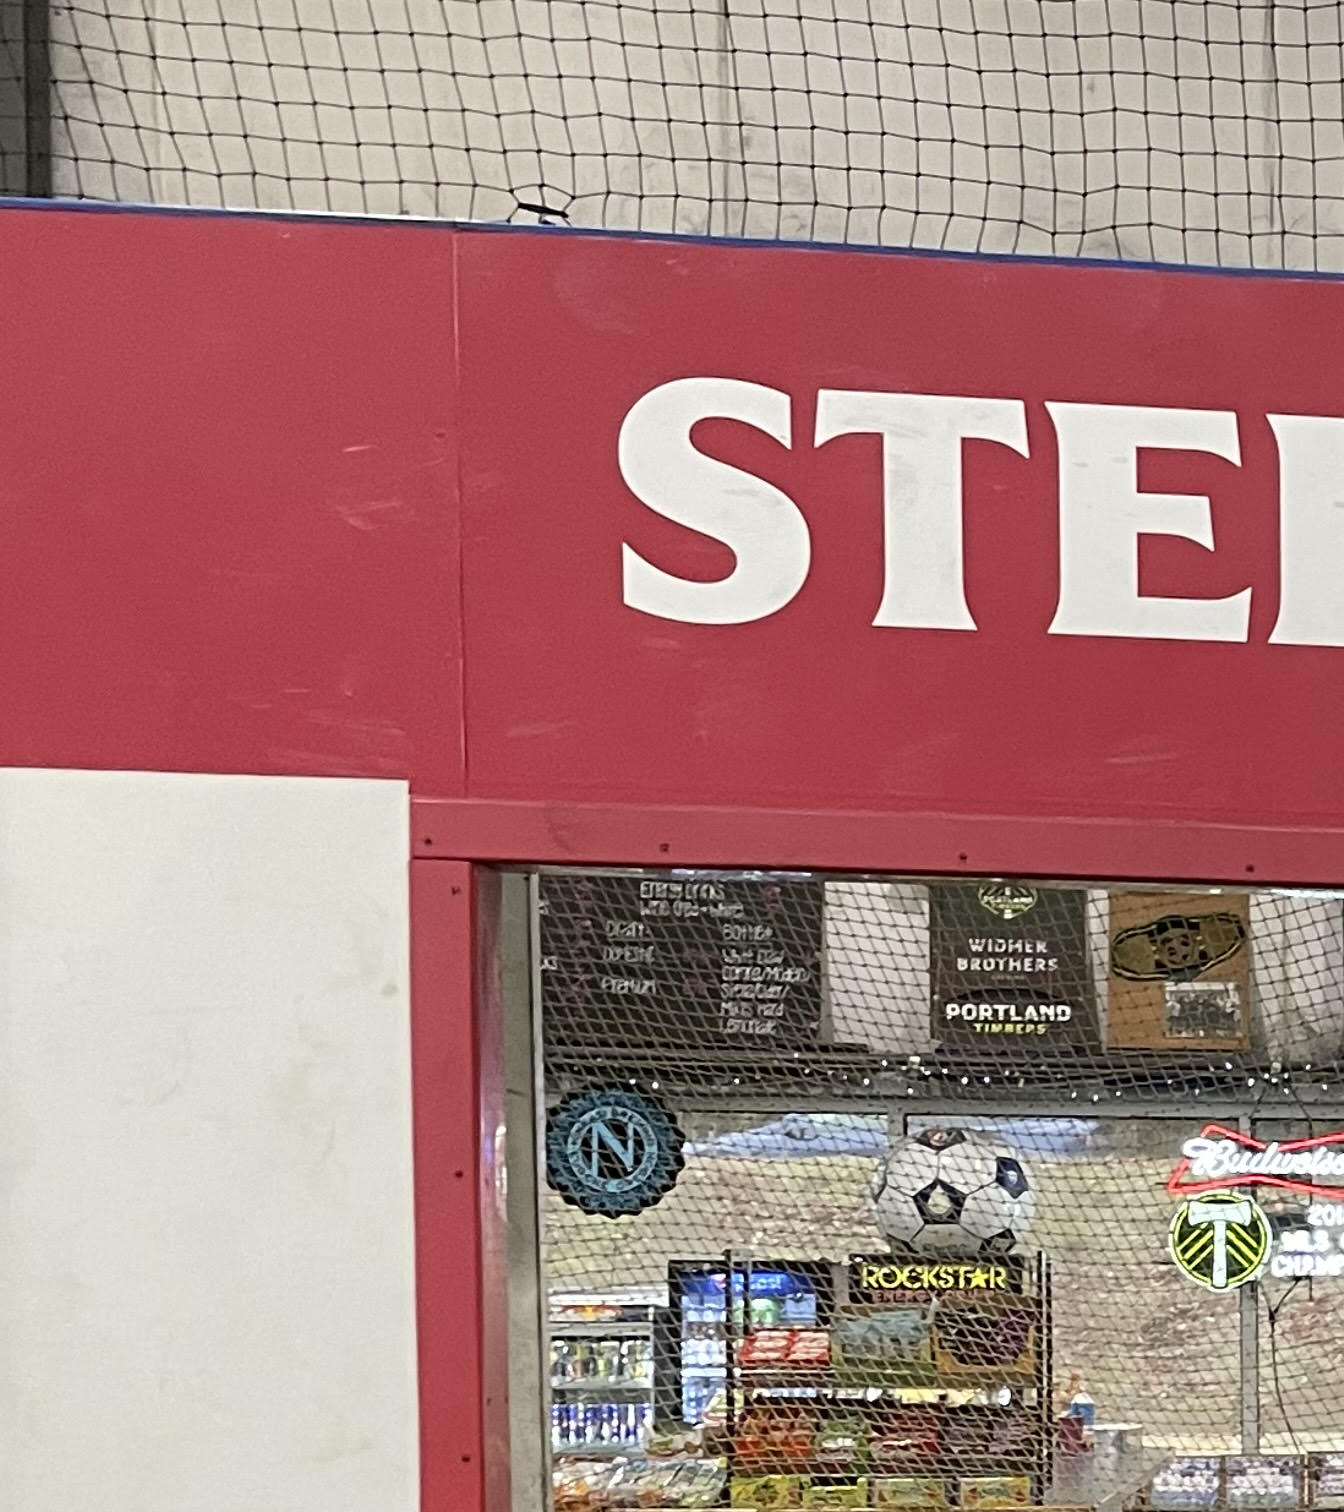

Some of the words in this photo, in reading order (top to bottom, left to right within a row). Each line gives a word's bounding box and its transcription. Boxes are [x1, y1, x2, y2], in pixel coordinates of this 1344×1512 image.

[968, 938, 1048, 953] WIDMER
[956, 957, 1058, 972] BROTHERS
[945, 1003, 1072, 1022] PORTLAND
